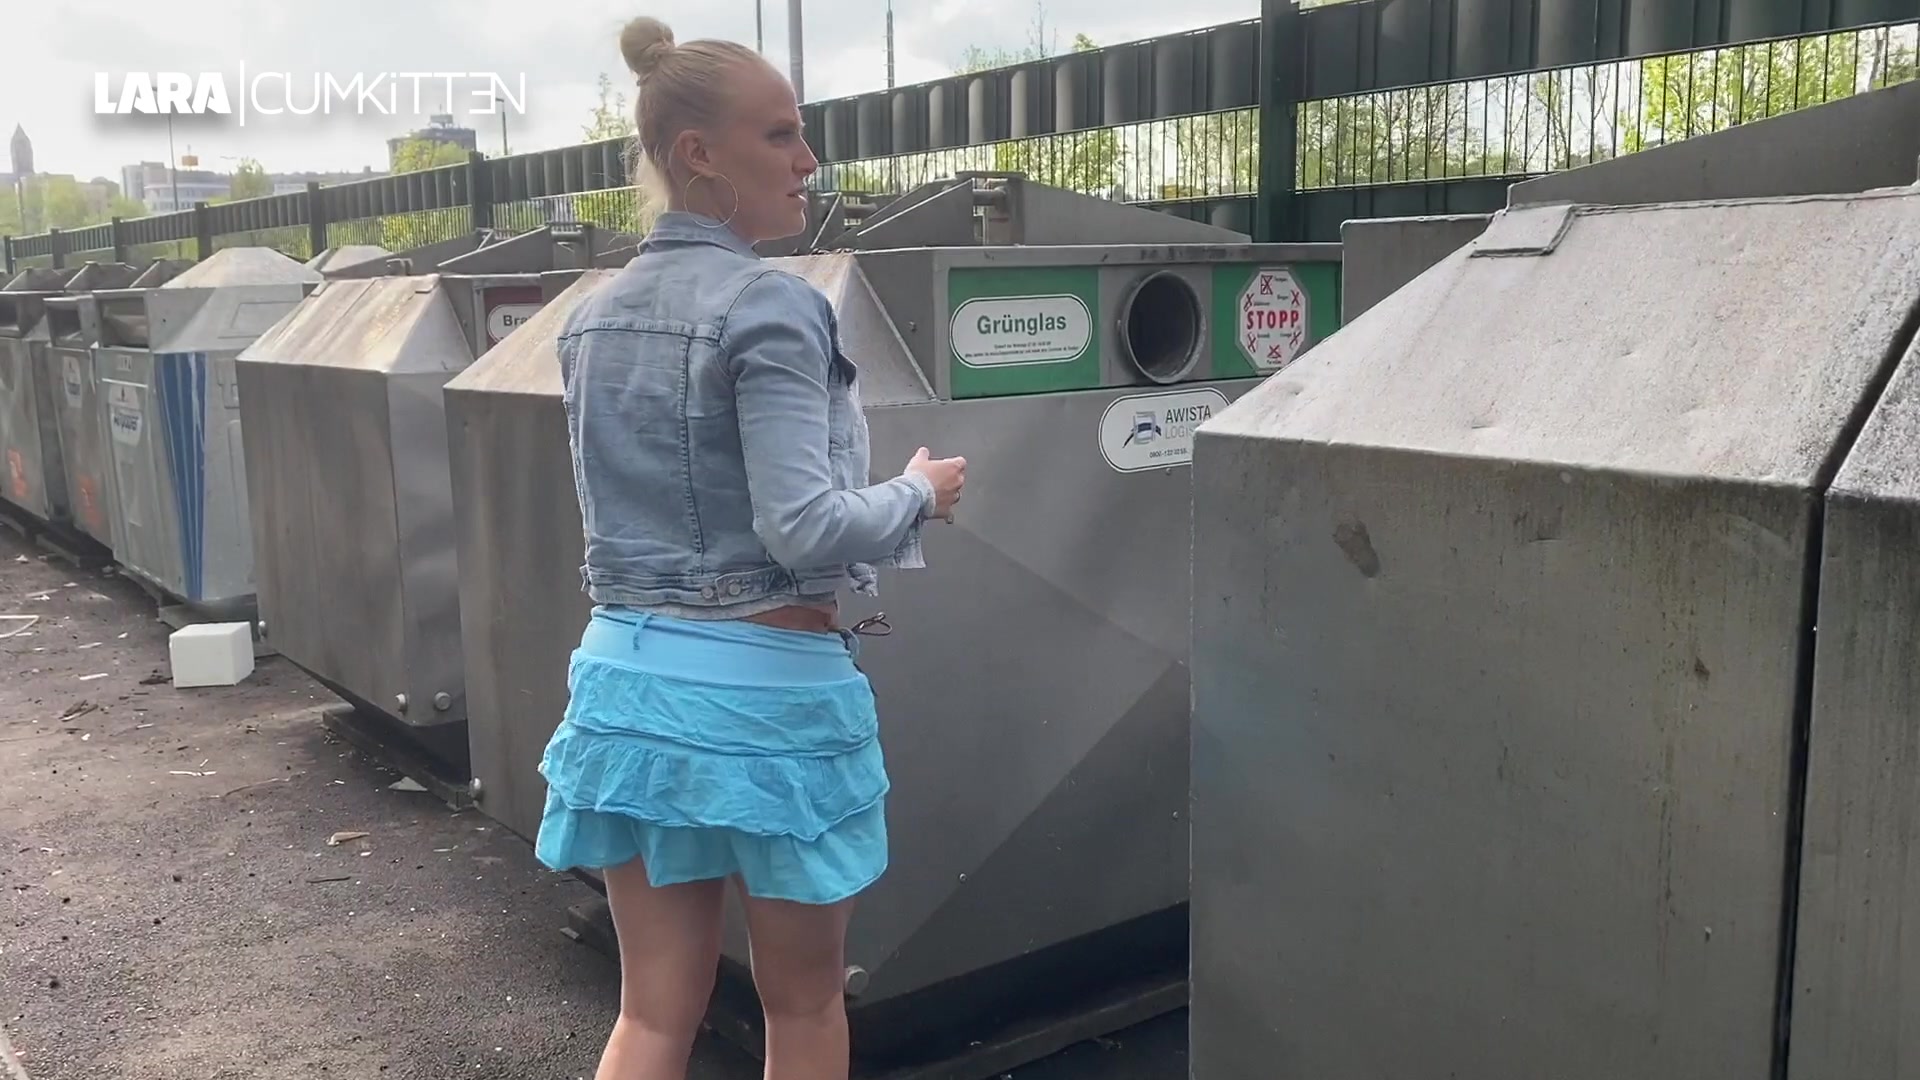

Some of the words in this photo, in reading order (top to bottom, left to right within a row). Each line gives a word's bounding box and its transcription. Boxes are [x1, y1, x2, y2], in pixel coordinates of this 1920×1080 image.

[503, 314, 532, 327] Bra
[976, 312, 1067, 336] Grünglas
[1246, 309, 1300, 330] STOPP
[1165, 404, 1212, 424] AWISTA
